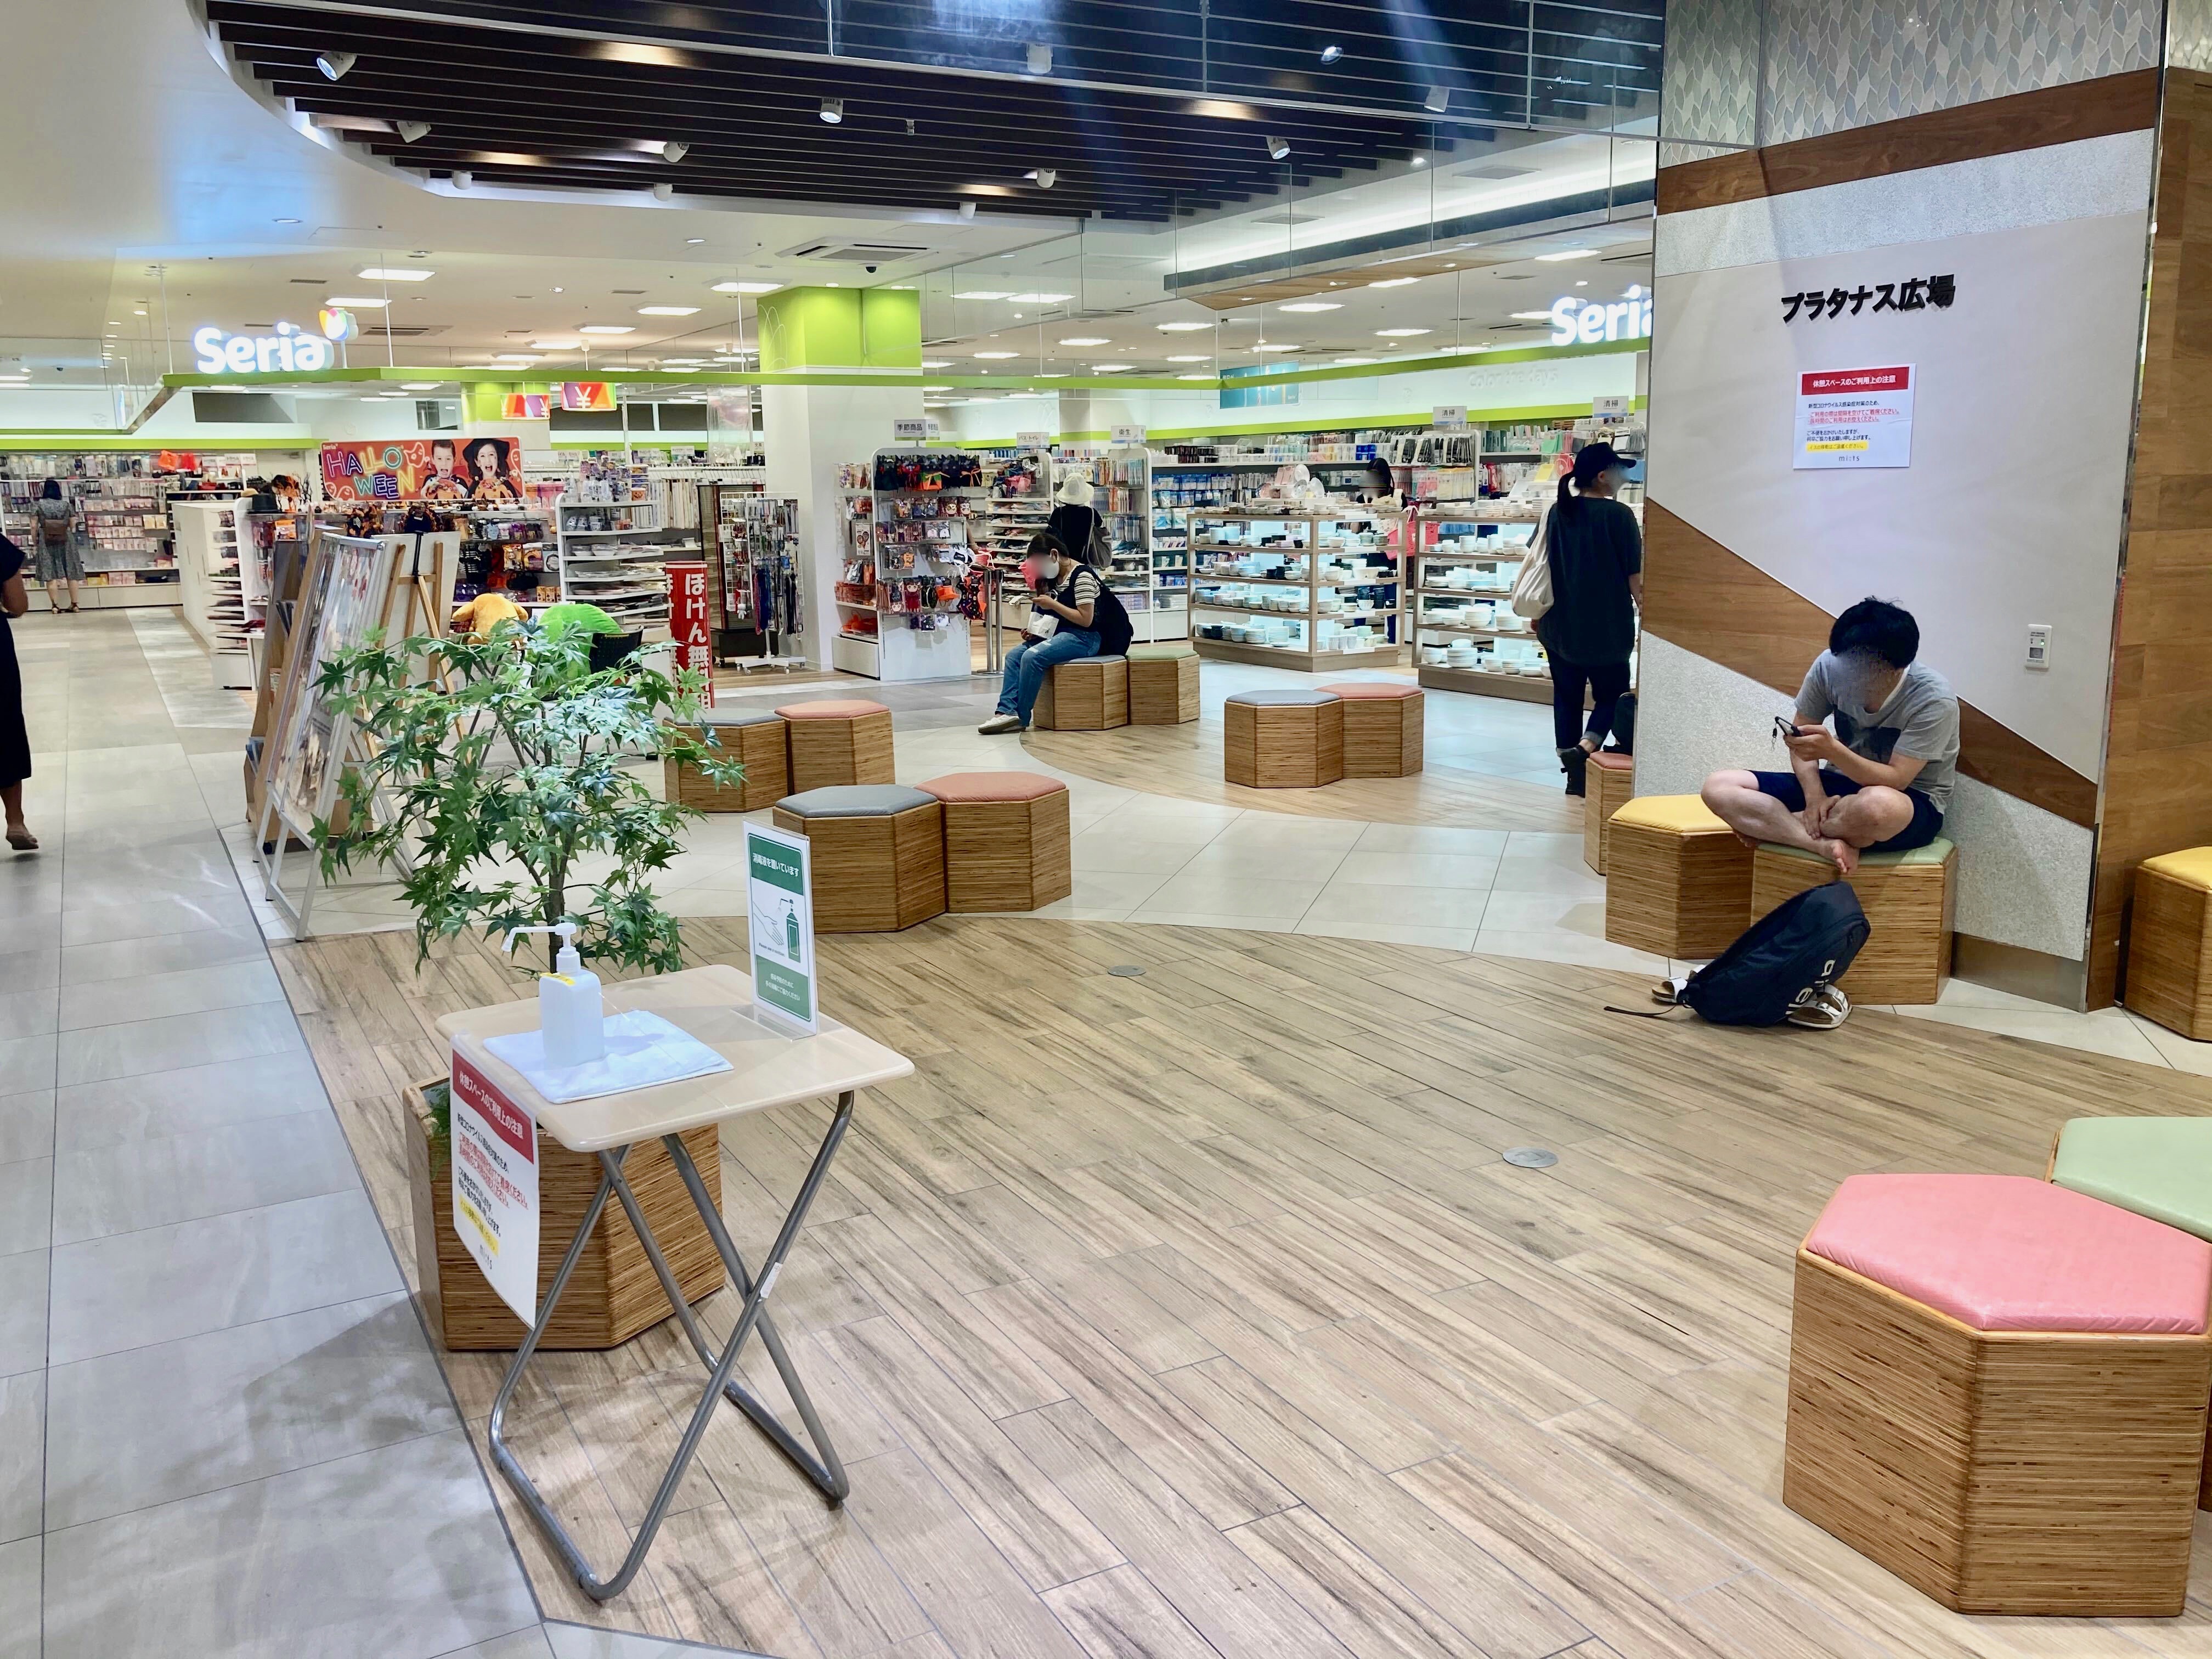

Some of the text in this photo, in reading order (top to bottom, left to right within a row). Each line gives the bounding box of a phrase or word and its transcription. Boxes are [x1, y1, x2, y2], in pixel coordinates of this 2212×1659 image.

[1781, 274, 1956, 324] プラタナス広場
[194, 321, 325, 374] Seria
[1813, 375, 1897, 388] 休憩スペースのご利用上の注意
[326, 446, 403, 478] HALLO
[353, 466, 415, 499] WEEN
